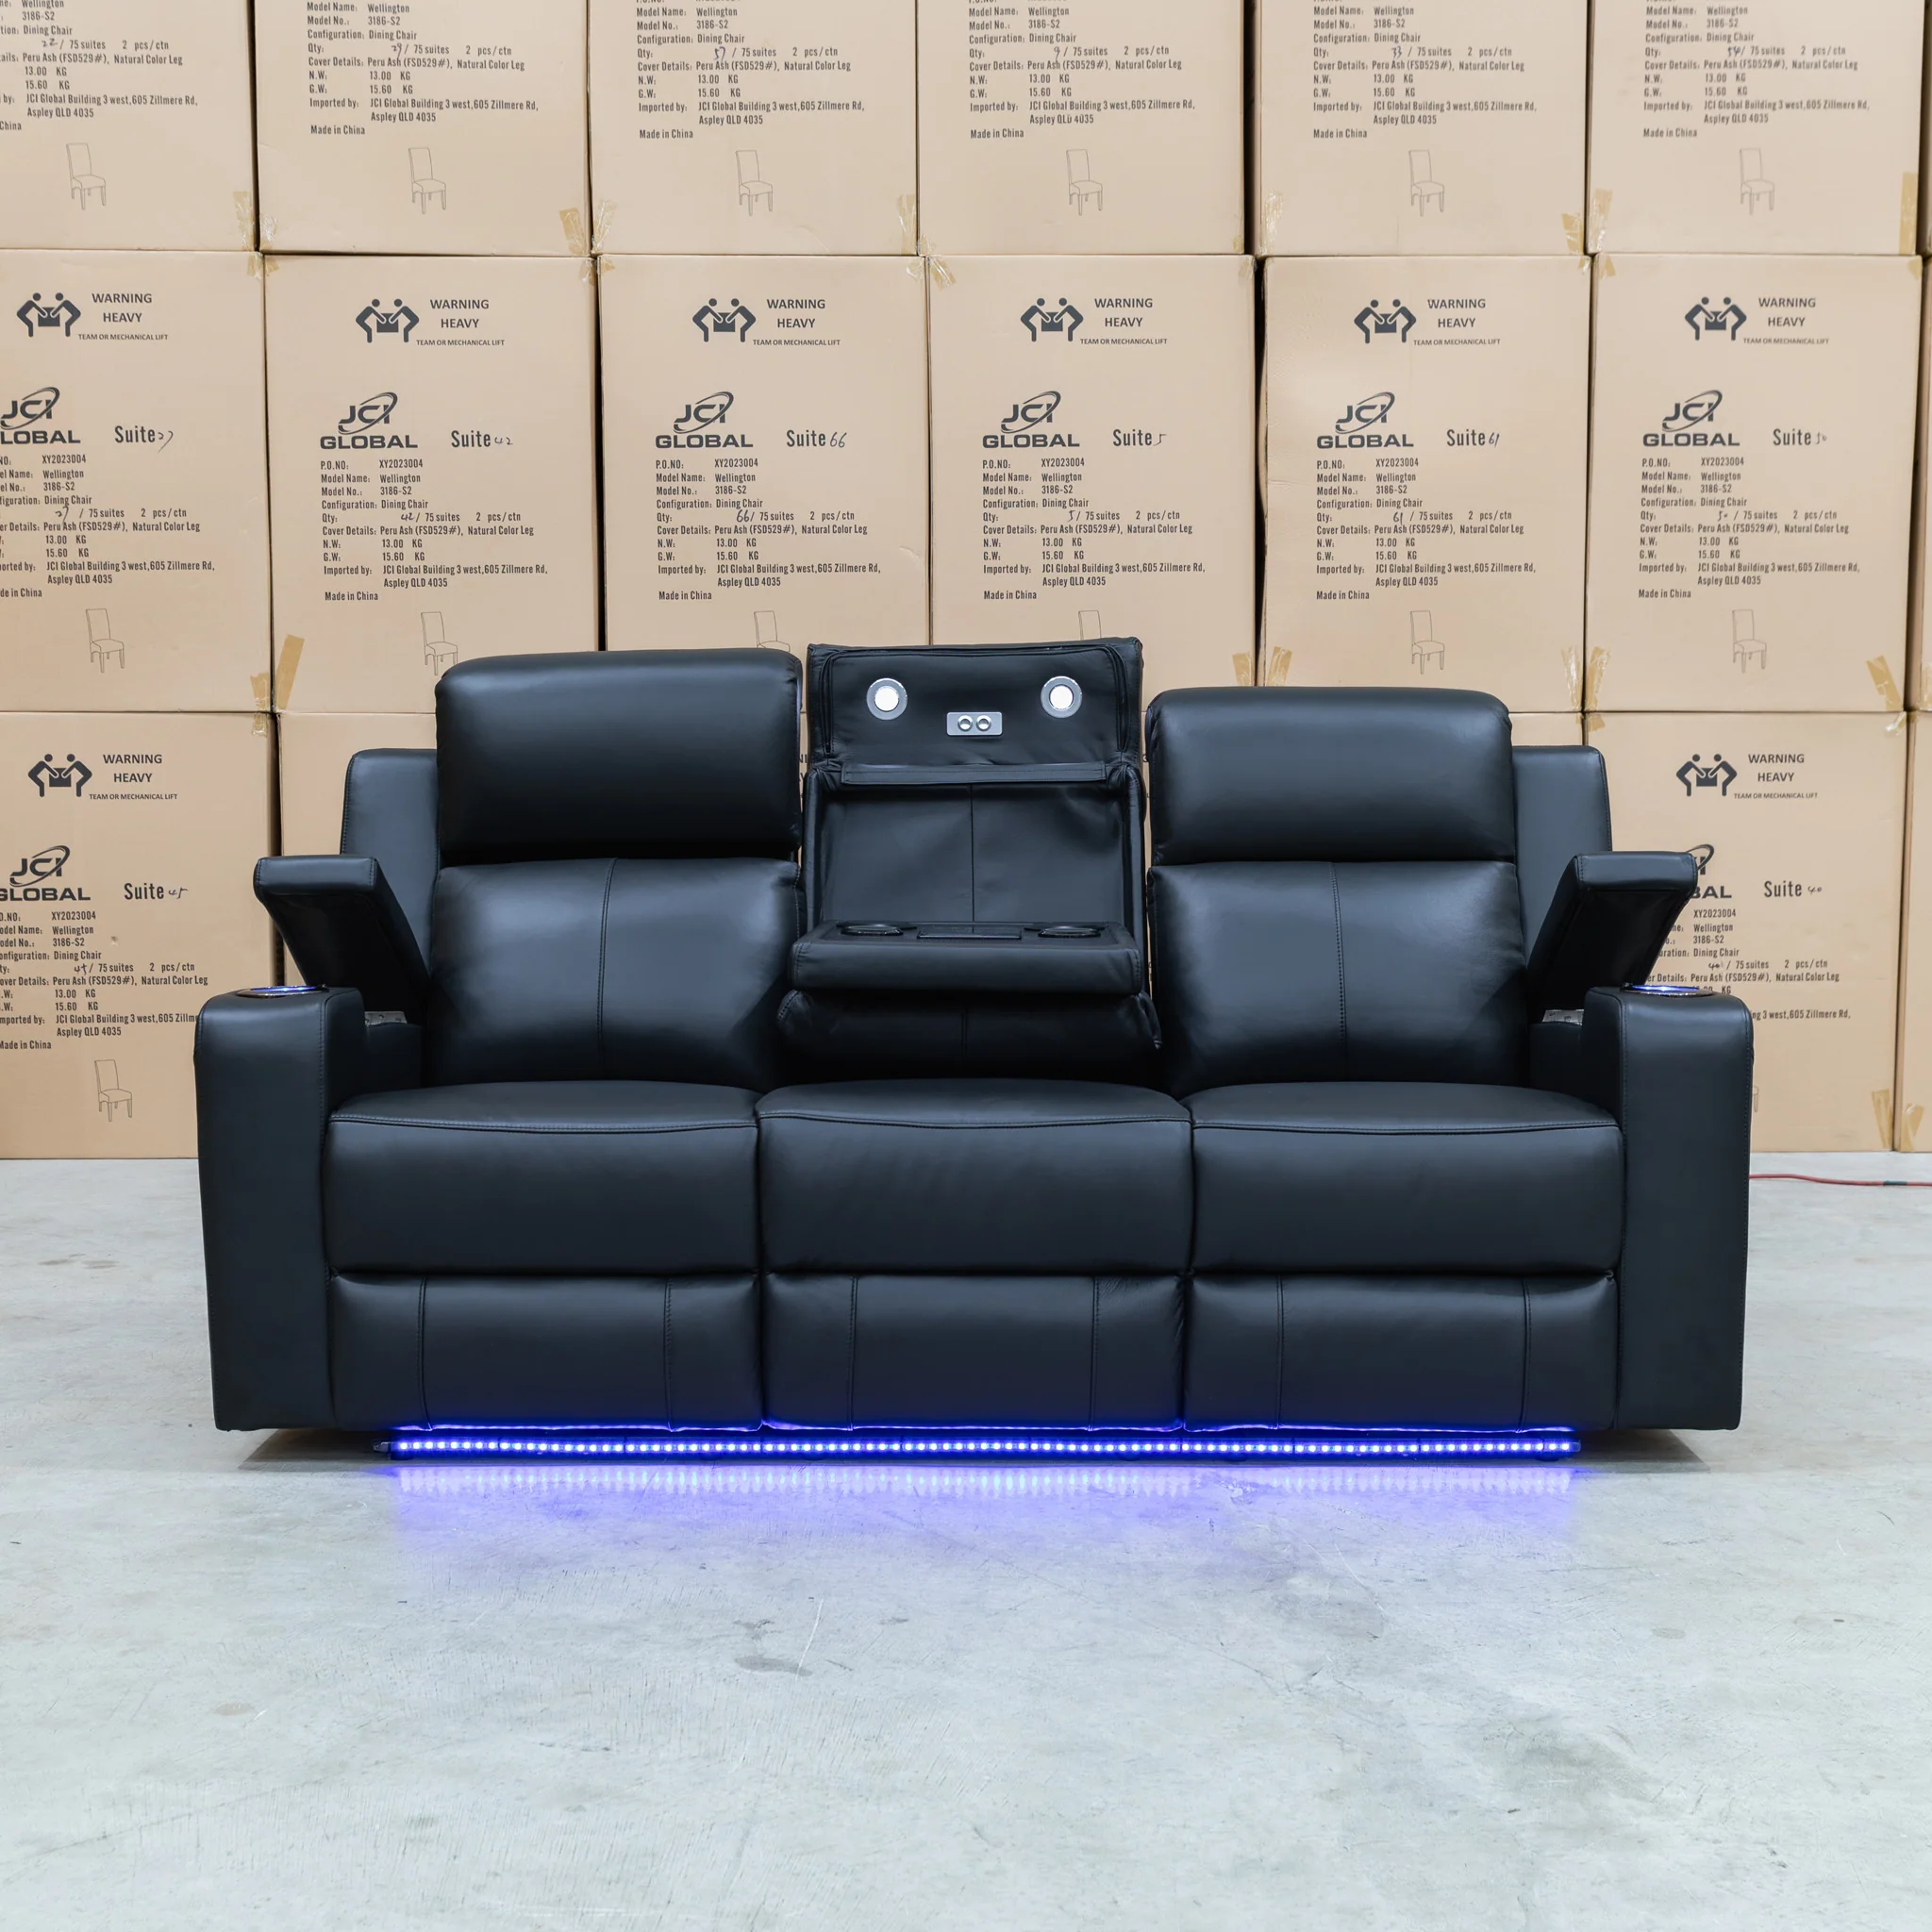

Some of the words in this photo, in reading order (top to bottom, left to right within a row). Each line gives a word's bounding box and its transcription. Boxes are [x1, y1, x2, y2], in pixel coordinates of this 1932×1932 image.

[306, 1, 331, 12] Model
[332, 1, 358, 12] Name:
[367, 2, 410, 15] Wellington
[1645, 5, 1671, 16] Model
[1706, 5, 1749, 18] Wellington
[307, 28, 365, 42] Configuration:
[368, 28, 395, 42] Dining
[395, 29, 418, 41] Chair
[25, 65, 48, 76] 13.00
[56, 65, 68, 77] KG
[637, 60, 660, 73] Cover
[660, 60, 692, 72] Details:
[695, 60, 715, 72] Peru
[714, 59, 730, 72] Ash
[783, 60, 814, 72] Natural
[814, 59, 837, 72] Color
[837, 59, 852, 73] Leg
[25, 79, 48, 91] 15.60
[58, 79, 71, 91] KG
[1313, 74, 1332, 85] N.W:
[1373, 73, 1395, 84] 13.00
[1403, 73, 1414, 84] KG
[970, 101, 1006, 114] Imported
[1007, 100, 1019, 113] by:
[1028, 100, 1041, 111] JCI
[1042, 99, 1068, 111] Global
[1069, 100, 1102, 113] Building
[1103, 99, 1108, 110] 3
[1147, 98, 1181, 110] Zillmere
[26, 106, 54, 120] Aspley
[55, 106, 72, 119] QLD
[73, 107, 94, 119] 4035
[1703, 112, 1731, 126] Aspley
[1731, 112, 1748, 125] QLD
[1748, 112, 1770, 124] 4035
[309, 124, 333, 135] Made
[333, 124, 342, 136] in
[342, 124, 366, 136] China
[1312, 127, 1335, 140] Made
[1335, 127, 1344, 139] in
[1344, 127, 1368, 140] China
[91, 292, 153, 304] WARNING
[429, 298, 490, 310] WARNING
[766, 298, 826, 309] WARNING
[1093, 297, 1154, 308] WARNING
[1426, 298, 1487, 309] WARNING
[1757, 297, 1817, 308] WARNING
[102, 311, 142, 324] HEAVY
[440, 317, 480, 329] HEAVY
[776, 317, 816, 329] HEAVY
[1104, 316, 1143, 328] HEAVY
[1437, 317, 1476, 328] HEAVY
[1767, 316, 1807, 327] HEAVY
[1443, 338, 1488, 346] MECHANICAL
[0, 429, 82, 445] LOBAL
[114, 425, 156, 444] Suite
[450, 429, 491, 448] Suite
[655, 433, 754, 449] GLOBAL
[786, 429, 826, 448] Suite
[829, 430, 848, 448] 66
[982, 433, 1081, 449] GLOBAL
[1112, 428, 1153, 447] Suite
[1446, 428, 1486, 447] Suite
[1488, 431, 1501, 447] 61
[1642, 432, 1740, 448] GLOBAL
[1773, 427, 1812, 446] Suite
[319, 434, 419, 450] GLOBAL
[1316, 433, 1415, 450] GLOBAL
[320, 459, 349, 471] P.O.NO:
[378, 458, 424, 469] XY2023004
[1641, 457, 1671, 469] P.O.NO:
[1700, 456, 1745, 467] XY2023004
[656, 485, 680, 496] Model
[680, 485, 698, 496] No.:
[714, 484, 747, 495] 3186-S2
[982, 498, 1039, 510] Configuration:
[1041, 497, 1068, 510] Dining
[1068, 497, 1090, 508] Chair
[1316, 525, 1340, 536] Cover
[1340, 524, 1371, 535] Details:
[1374, 524, 1392, 535] Peru
[1392, 524, 1407, 535] Ash
[1459, 524, 1489, 535] Natural
[1489, 523, 1510, 534] Color
[1510, 524, 1524, 536] Leg
[322, 539, 341, 549] N.W:
[381, 538, 404, 549] 13.00
[411, 538, 424, 549] KG
[323, 551, 341, 562] G.W:
[381, 551, 405, 562] 15.60
[414, 551, 425, 562] KG
[1639, 562, 1674, 575] Imported
[1675, 562, 1688, 575] by:
[1697, 561, 1710, 573] JCI
[1710, 561, 1737, 573] Global
[1737, 561, 1770, 575] Building
[1770, 561, 1776, 573] 3
[1813, 561, 1847, 573] Zillmere
[46, 574, 74, 587] Aspley
[74, 574, 91, 585] QLD
[92, 574, 113, 585] 4035
[983, 590, 1005, 600] Made
[1006, 590, 1014, 600] in
[1014, 589, 1038, 600] China
[102, 754, 163, 765] WARNING
[1747, 753, 1805, 764] WARNING
[113, 772, 153, 783] HEAVY
[1757, 772, 1795, 783] HEAVY
[88, 792, 109, 801] TEAM
[108, 792, 120, 801] OR
[120, 792, 164, 801] MECHANICAL
[0, 887, 92, 903] GLOBAL
[124, 882, 165, 901] Suite
[1763, 879, 1803, 898] Suite
[50, 909, 97, 922] XY2023004
[1692, 908, 1737, 919] XY2023004
[1692, 923, 1734, 935] Wellington
[1692, 947, 1719, 959] Dining
[1719, 946, 1740, 958] Chair
[56, 1026, 83, 1039] Aspley
[83, 1025, 100, 1038] QLD
[101, 1025, 122, 1037] 4035
